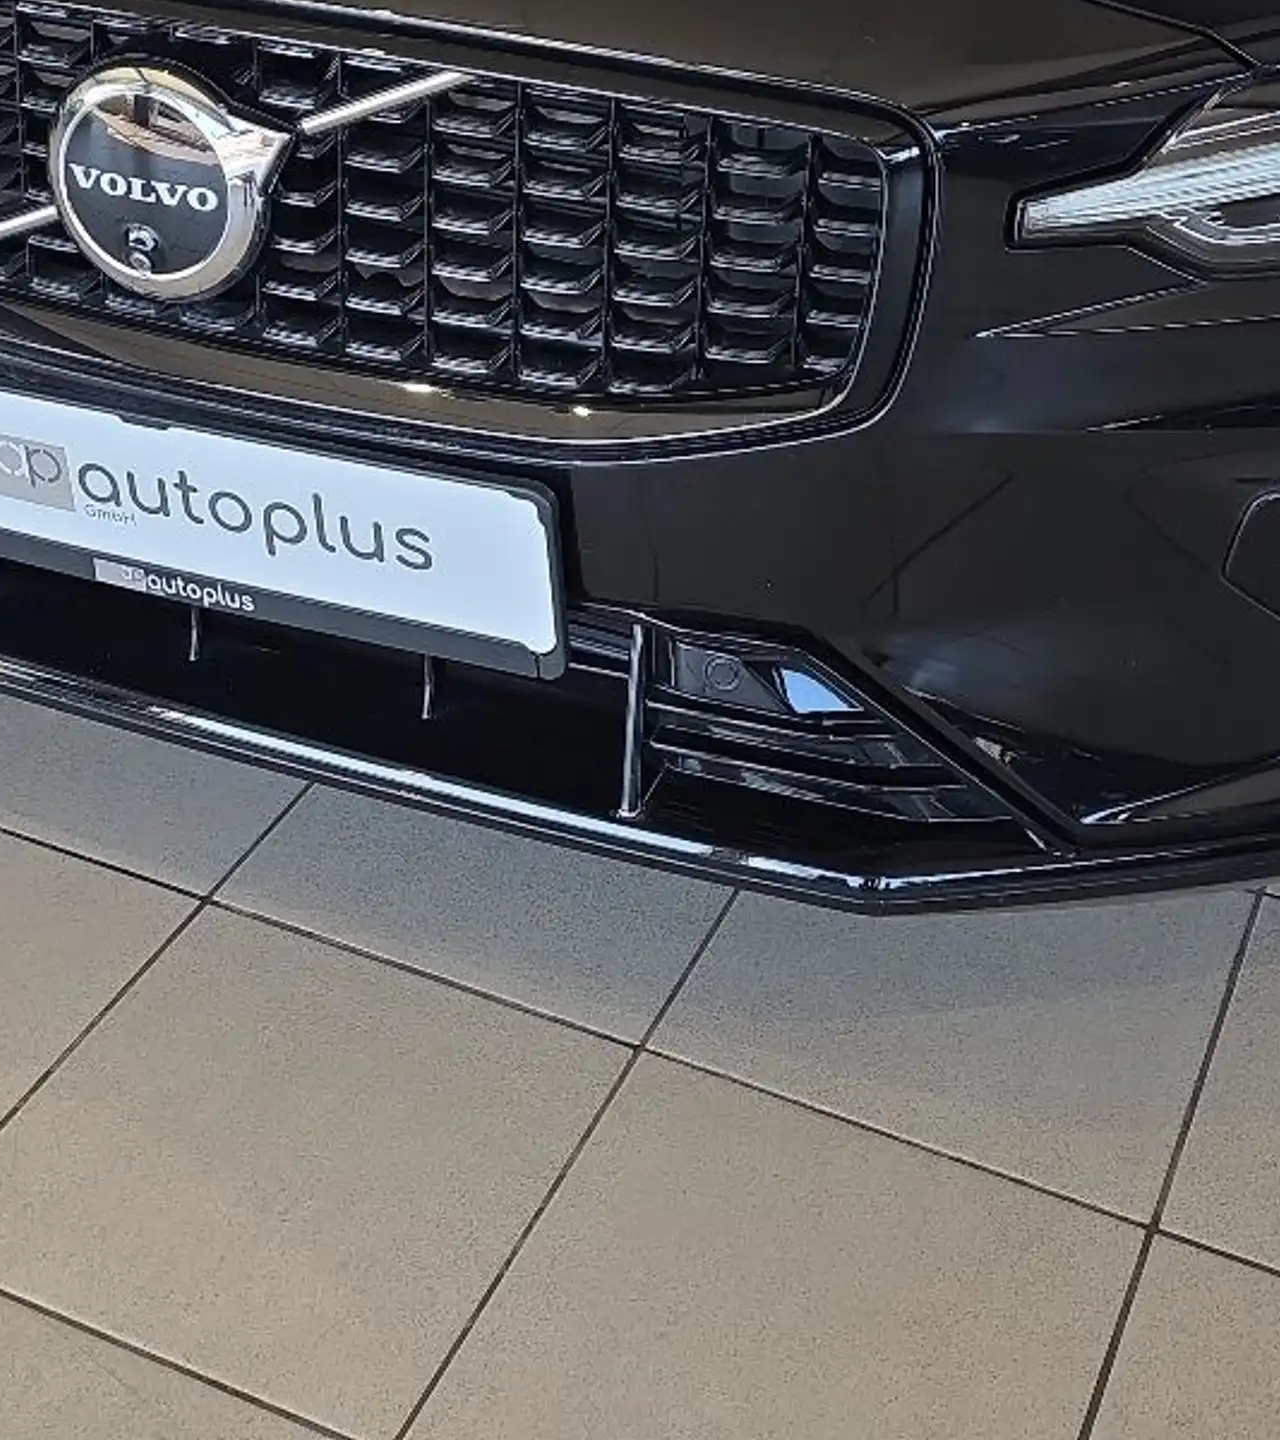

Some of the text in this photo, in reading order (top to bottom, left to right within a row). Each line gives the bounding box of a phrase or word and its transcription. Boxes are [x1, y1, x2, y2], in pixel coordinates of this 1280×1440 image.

[68, 163, 219, 211] VOLVO
[78, 463, 432, 570] autoplus
[83, 504, 137, 526] GmbH
[148, 573, 256, 612] autoplus
